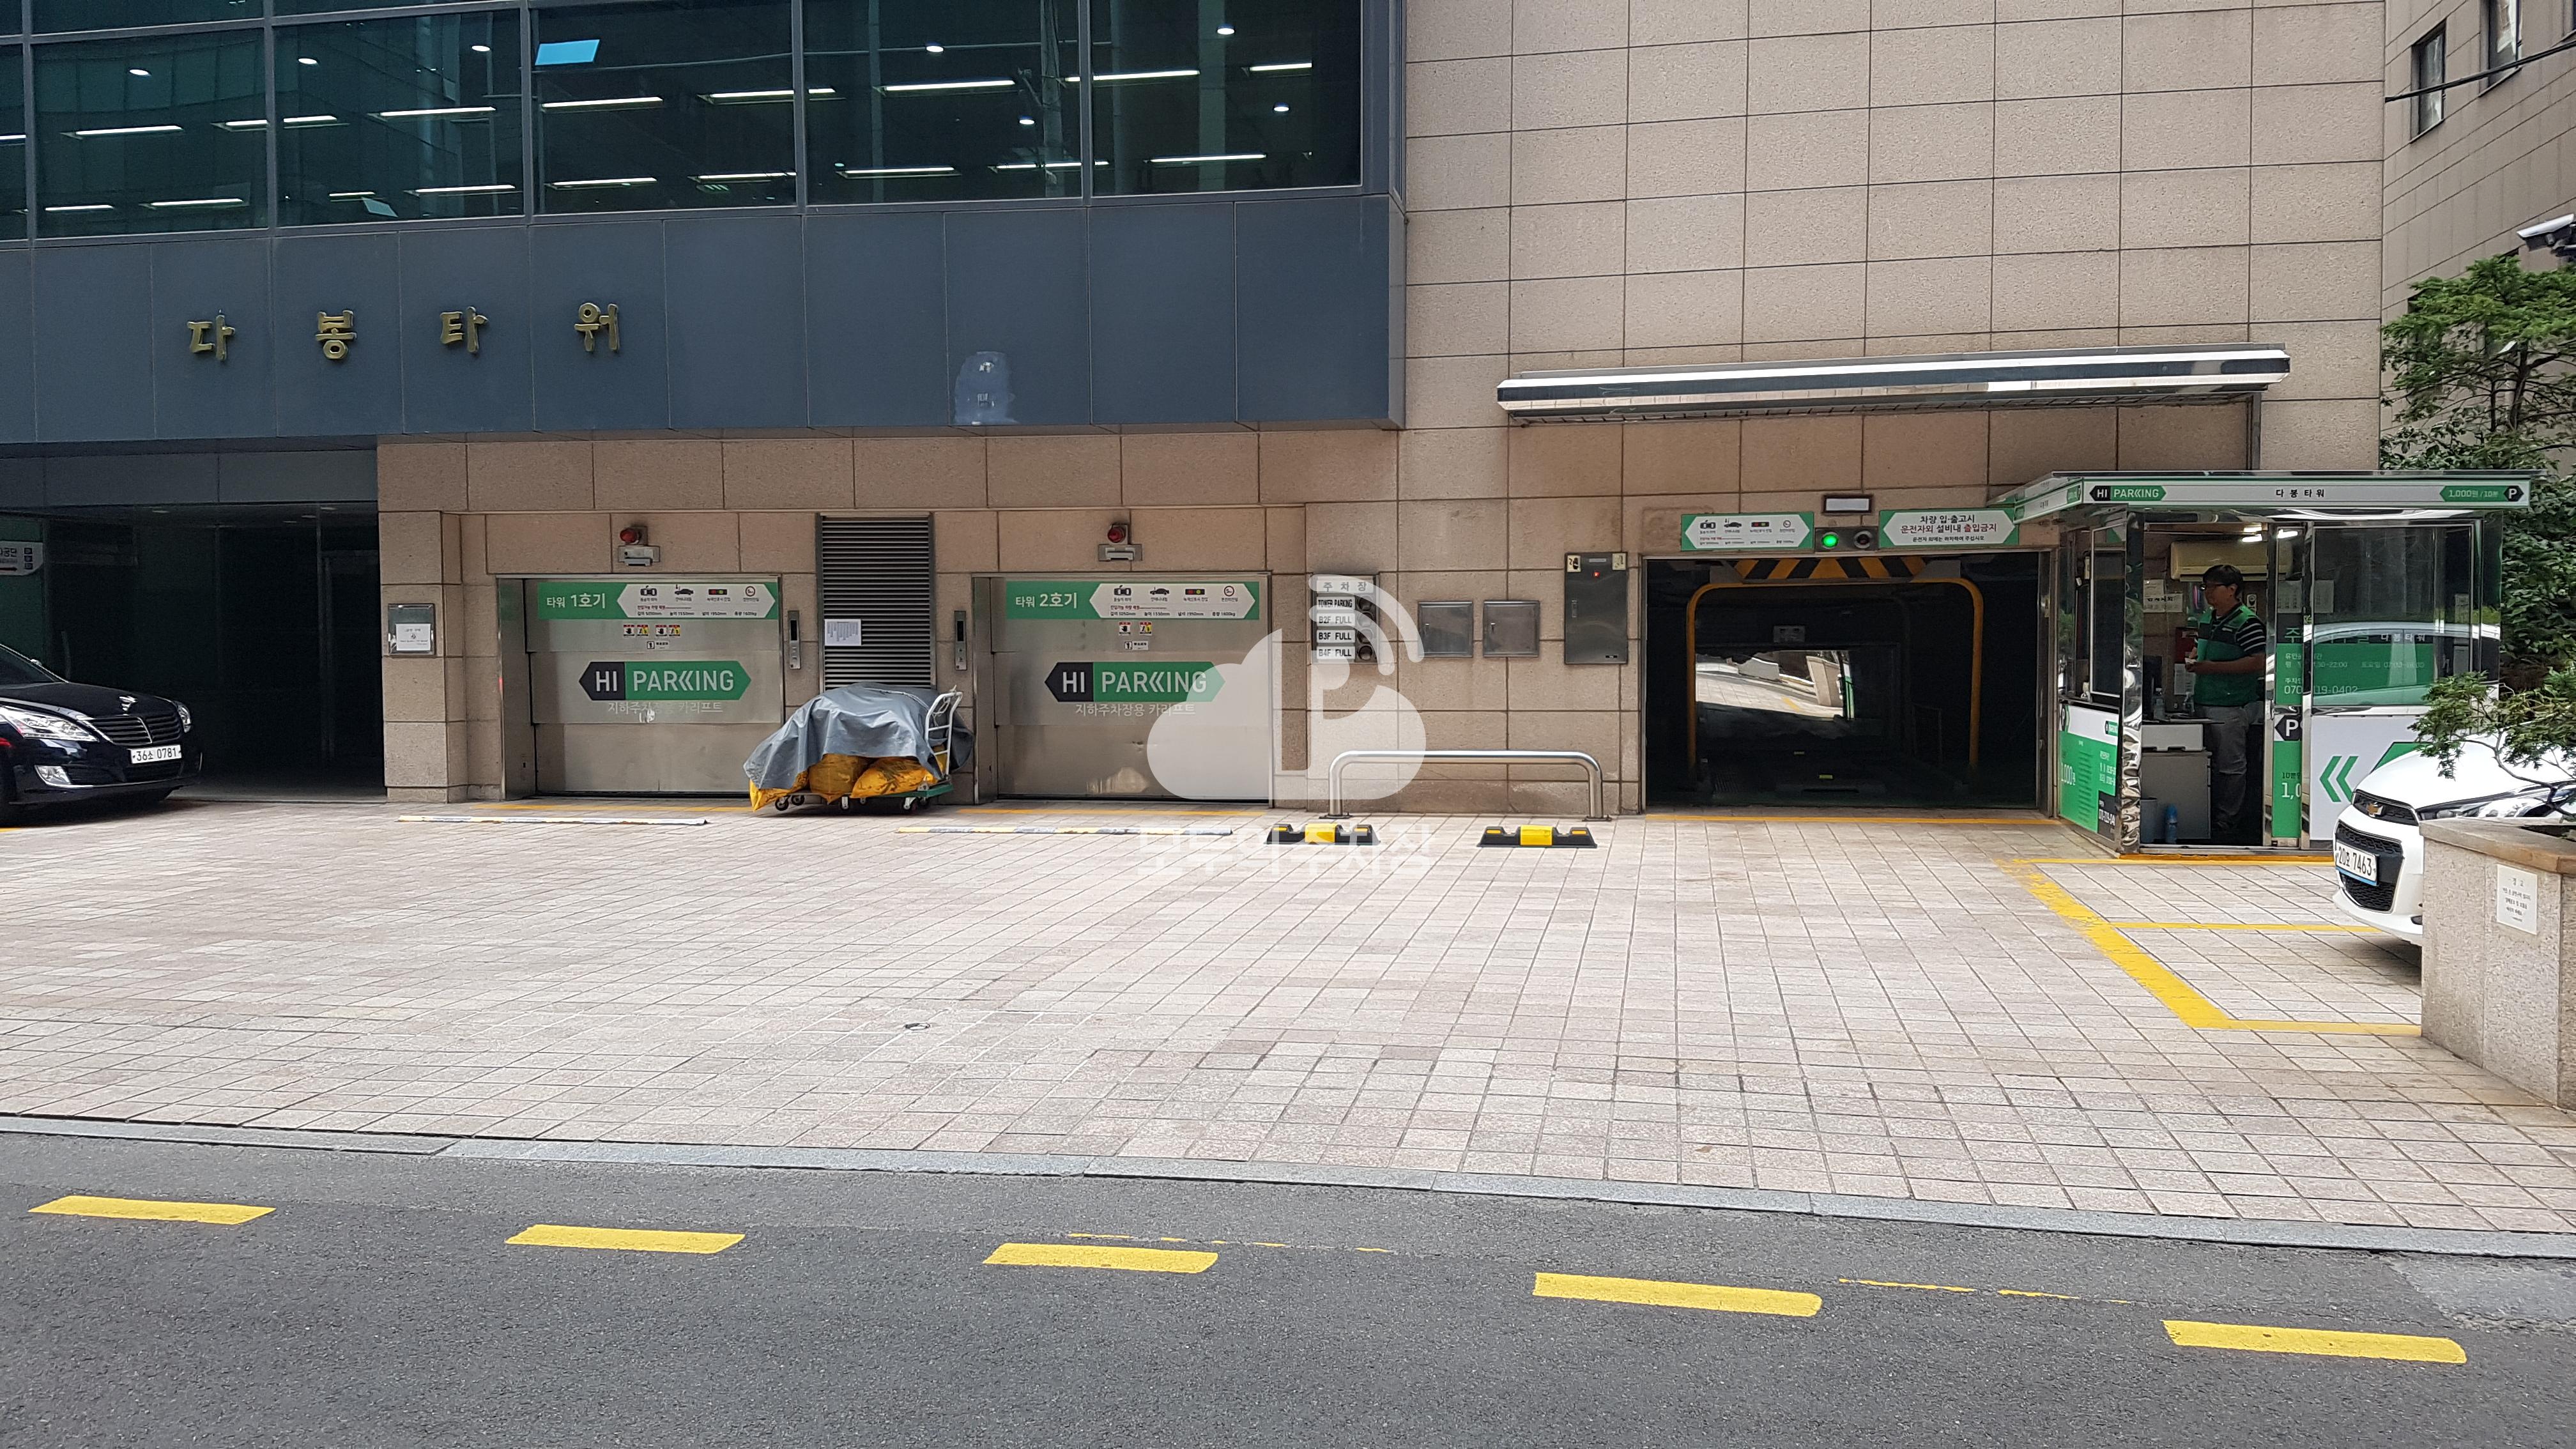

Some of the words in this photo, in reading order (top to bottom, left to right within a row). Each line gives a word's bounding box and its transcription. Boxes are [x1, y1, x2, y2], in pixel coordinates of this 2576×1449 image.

[2097, 489, 2108, 498] HI
[2113, 489, 2159, 498] PARKING
[2508, 487, 2517, 499] P
[1920, 515, 1937, 524] 차량
[1901, 525, 1933, 534] 운전자외
[1936, 524, 1961, 533] 설비내
[1964, 523, 1997, 532] 출입금지
[546, 597, 565, 608] 타워
[571, 592, 606, 609] 1호기
[1015, 596, 1035, 608] 타워
[1039, 592, 1077, 609] 2호기
[1318, 599, 1333, 608] TOWER
[1334, 599, 1353, 608] PARKING
[1319, 616, 1331, 624] B2F
[1335, 615, 1352, 624] FULL
[1318, 632, 1331, 640] B3F
[1335, 632, 1352, 640] FULL
[1318, 648, 1331, 657] B4F
[1335, 648, 1352, 657] FULL
[595, 671, 617, 692] HI
[633, 670, 734, 691] PARKING
[1062, 671, 1085, 693] HI
[1102, 671, 1207, 693] PARKING
[1075, 703, 1145, 717] 지하주차장용
[1149, 703, 1196, 716] 카리프트
[2285, 719, 2299, 737] P
[136, 750, 154, 762] 36소
[157, 747, 177, 759] 0781
[2352, 852, 2372, 877] 7463
